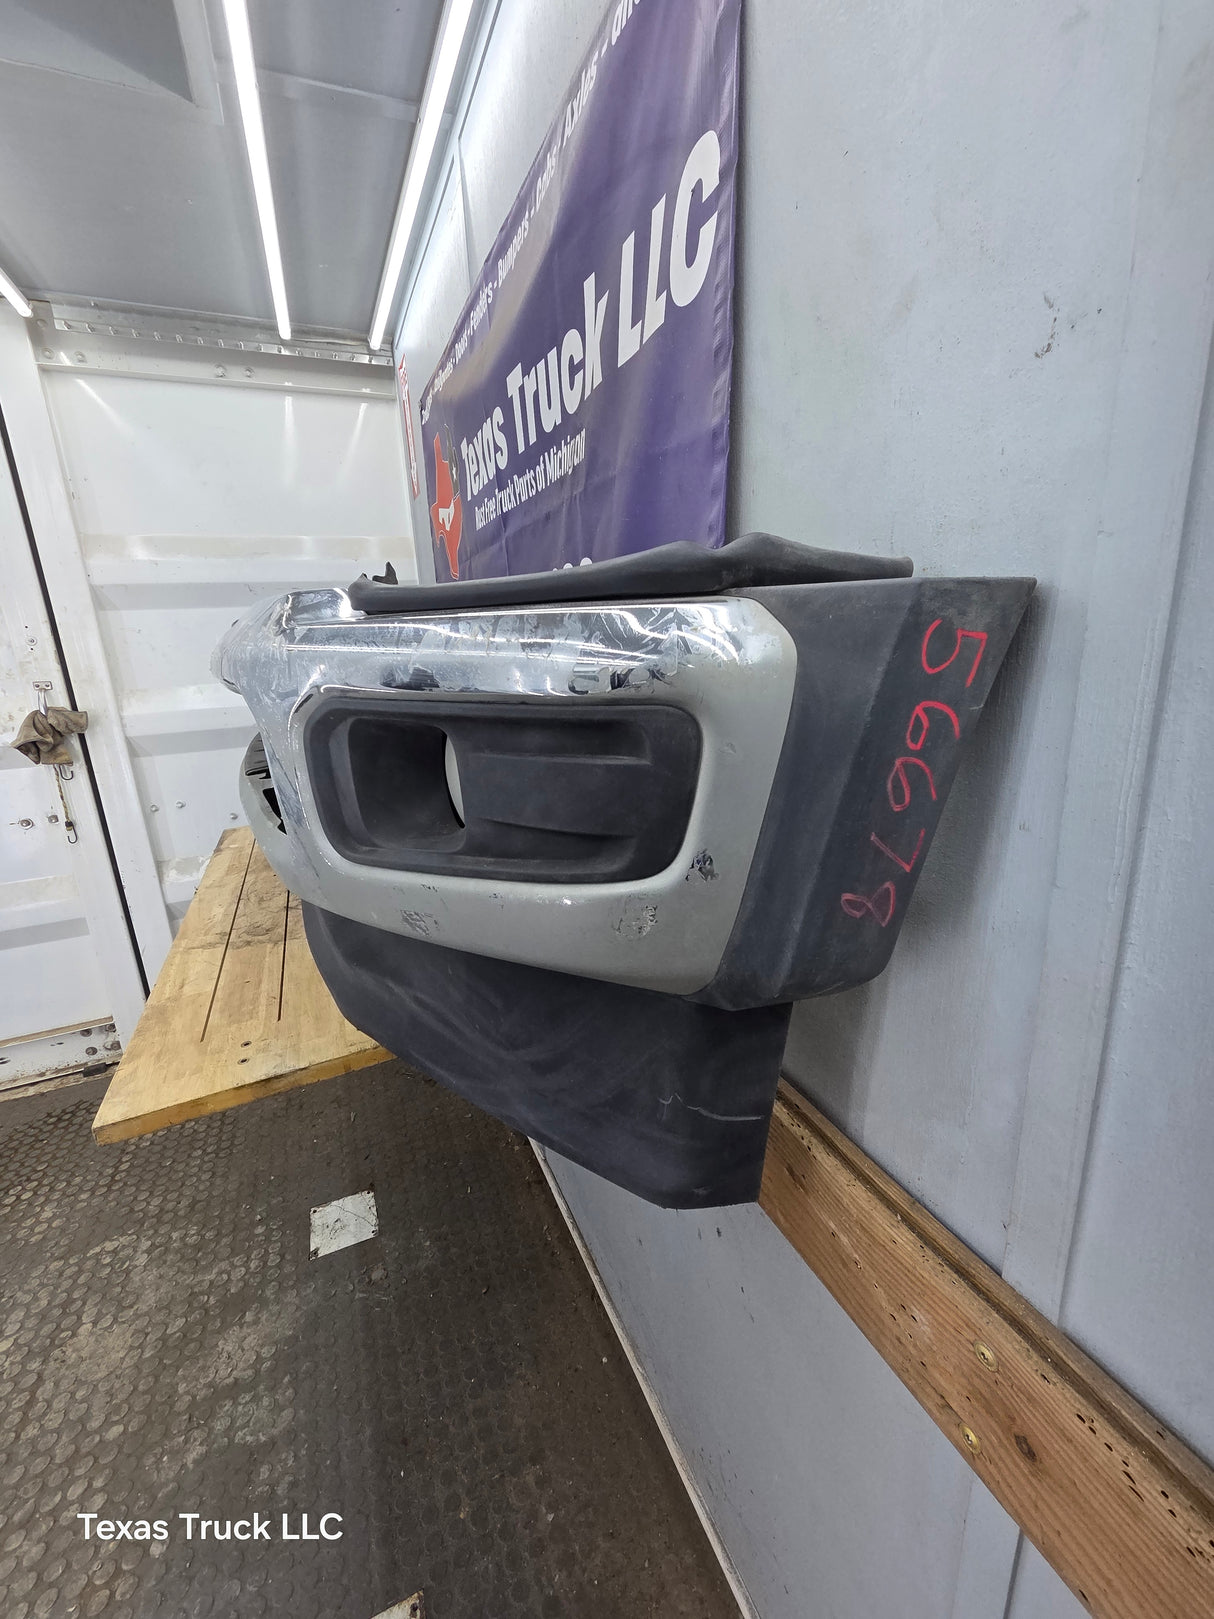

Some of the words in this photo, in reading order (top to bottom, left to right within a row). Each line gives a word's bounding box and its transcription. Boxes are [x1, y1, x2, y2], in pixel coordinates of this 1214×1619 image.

[460, 407, 508, 502] Texas
[507, 272, 609, 454] Truck
[618, 130, 721, 369] LLC
[470, 281, 493, 336] Fenders
[497, 211, 529, 288] Bumpers
[563, 51, 599, 148] Axles
[475, 503, 485, 531] Rust
[485, 497, 496, 523] Free
[495, 480, 516, 516] Truck
[513, 469, 536, 505] Parts
[536, 455, 545, 492] of
[545, 428, 586, 487] Michigan
